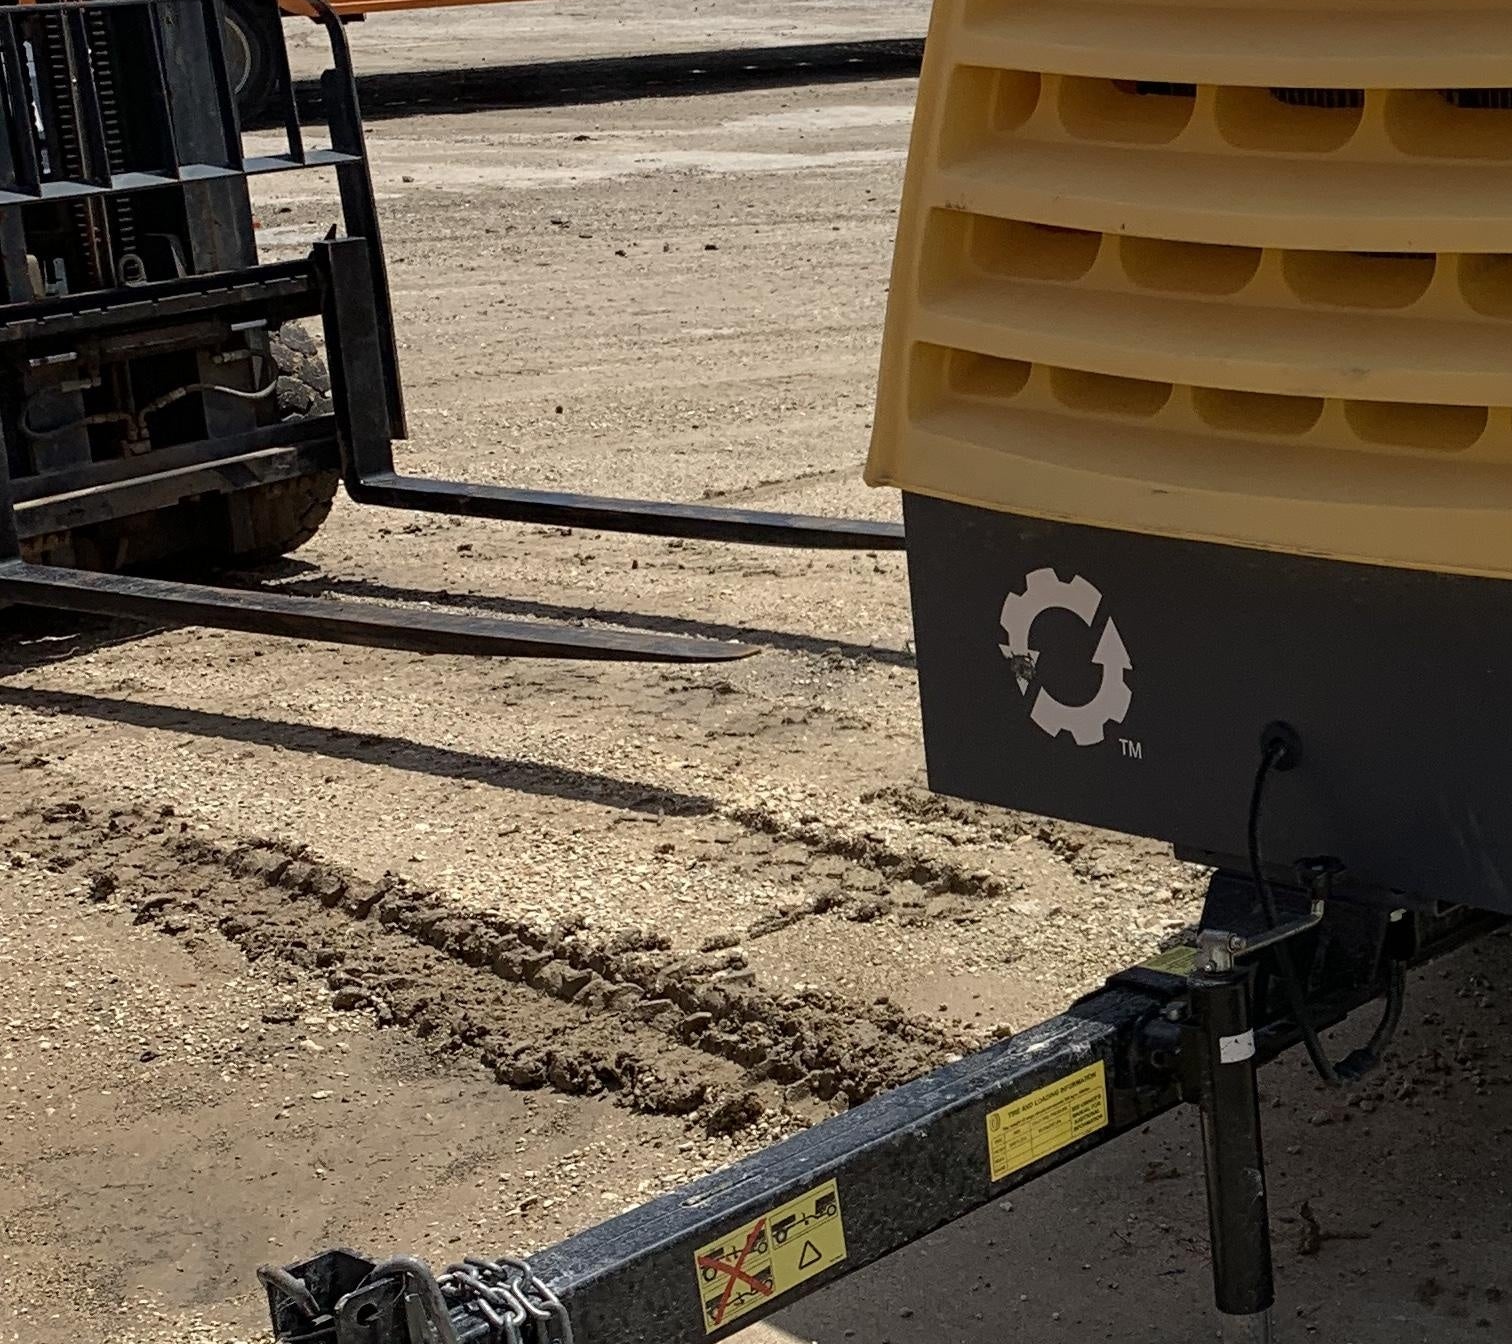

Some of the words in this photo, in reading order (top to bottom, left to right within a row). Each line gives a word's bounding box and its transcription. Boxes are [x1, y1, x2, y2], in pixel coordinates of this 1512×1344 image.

[1119, 738, 1142, 759] TM
[1022, 1102, 1034, 1112] AND
[1034, 1089, 1059, 1106] LOADING
[1060, 1072, 1097, 1093] INFORMATION
